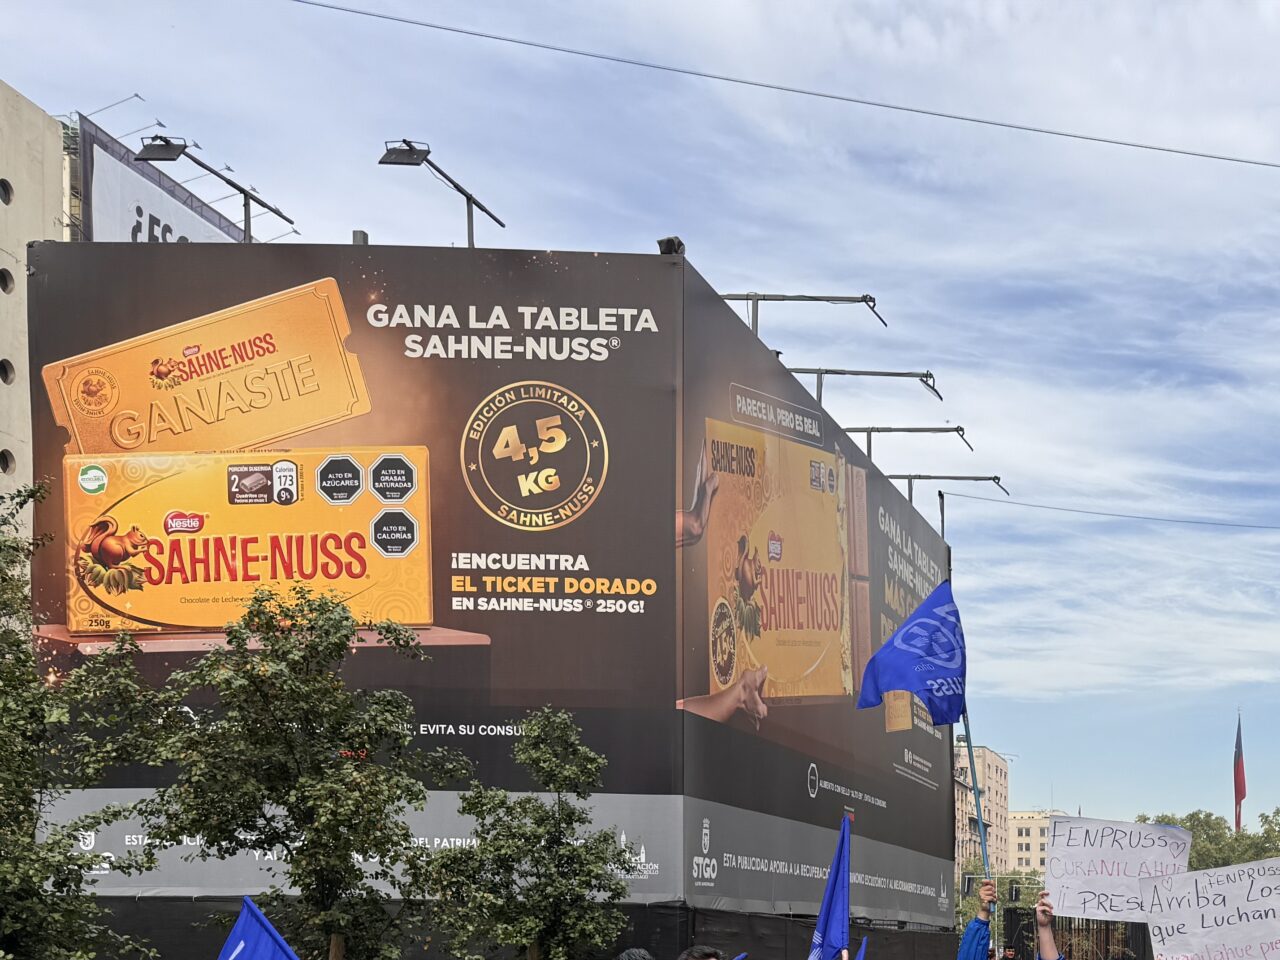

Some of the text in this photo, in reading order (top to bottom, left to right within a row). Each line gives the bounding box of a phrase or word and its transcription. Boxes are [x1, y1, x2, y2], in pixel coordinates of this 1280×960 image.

[366, 303, 660, 333] GANA LA TABLETA
[176, 332, 278, 382] SAHNE-NUSS
[110, 354, 320, 449] GANASTE
[469, 386, 586, 440] EDICIÓN LIMITADA
[735, 394, 767, 420] PARECE
[776, 408, 795, 429] PERO
[803, 417, 821, 437] REAL
[492, 414, 567, 465] 4,5
[231, 475, 239, 492] 2
[277, 475, 294, 487] 173
[322, 479, 359, 487] AZÚCARES
[517, 468, 561, 497] KG
[280, 491, 290, 501] 9%
[377, 532, 412, 540] CALORÍAS
[878, 505, 942, 585] GANA LA TABLETA
[142, 530, 367, 586] SAHNE-NUSS
[451, 552, 590, 572] ¡ENCUENTRA
[451, 575, 657, 595] EL TICKET DORADO
[760, 565, 839, 632] SAHNE-NUSS
[452, 597, 475, 611] EN
[88, 619, 111, 629] 250g
[420, 724, 455, 735] EVITA
[458, 724, 475, 735] SU
[1050, 821, 1168, 850] FENPRUSS
[693, 856, 717, 879] STGO
[723, 852, 736, 868] ESTA
[737, 855, 768, 872] PUBLICIDAD
[769, 859, 789, 875] APORTA
[789, 863, 793, 875] A
[1149, 879, 1227, 914] Arriba
[1152, 907, 1277, 946] que Luchan
